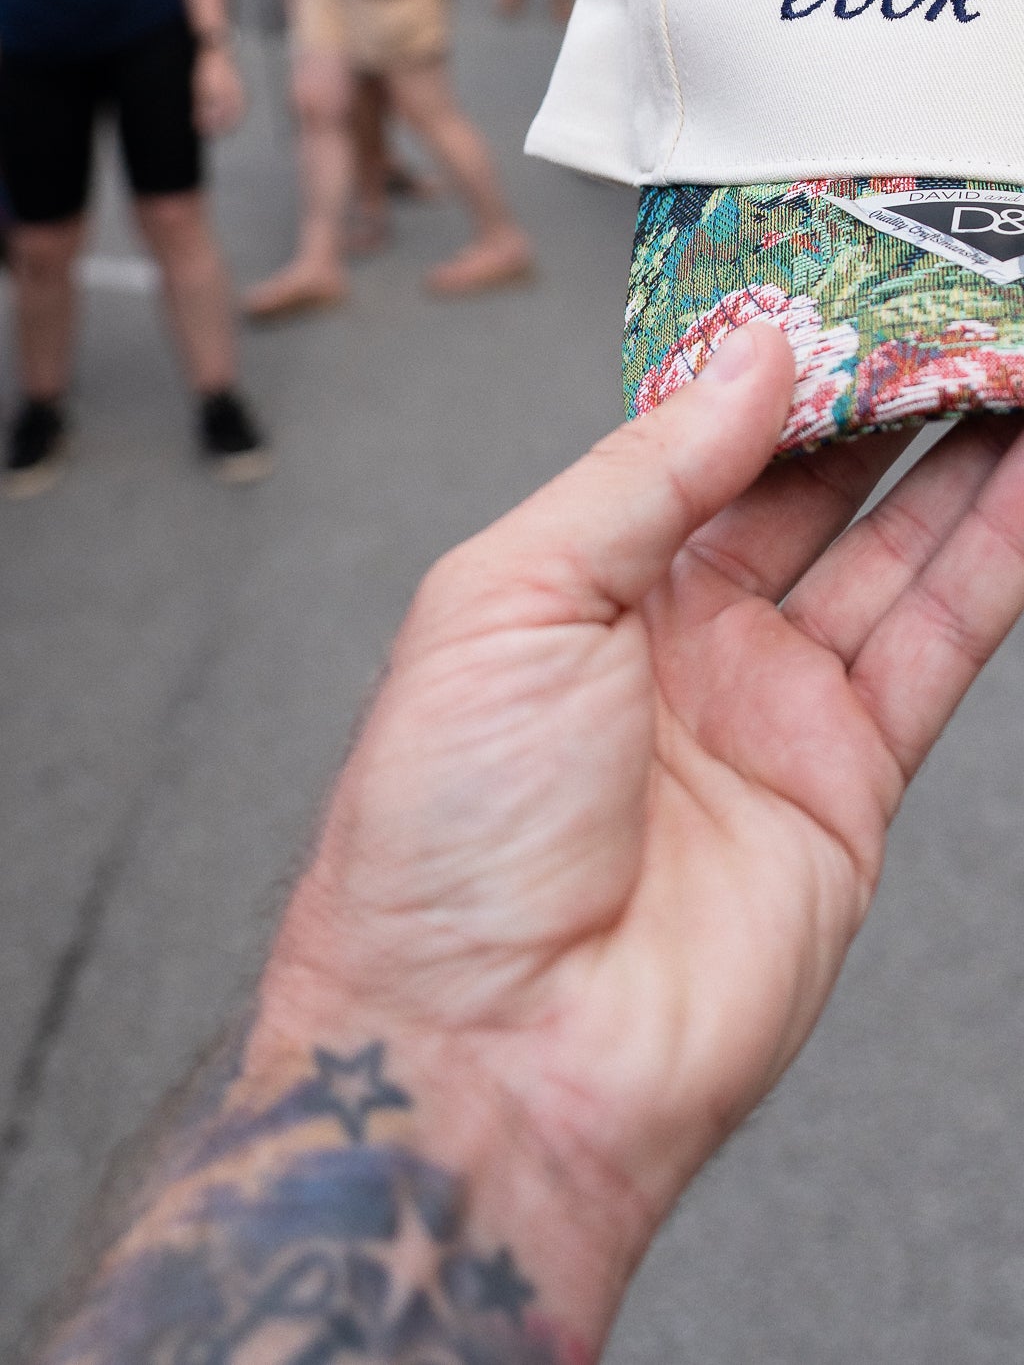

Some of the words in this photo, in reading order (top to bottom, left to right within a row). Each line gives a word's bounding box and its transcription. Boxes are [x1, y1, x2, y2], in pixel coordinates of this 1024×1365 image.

[909, 190, 980, 202] DAVID
[984, 192, 1022, 203] and
[868, 209, 909, 231] Quality
